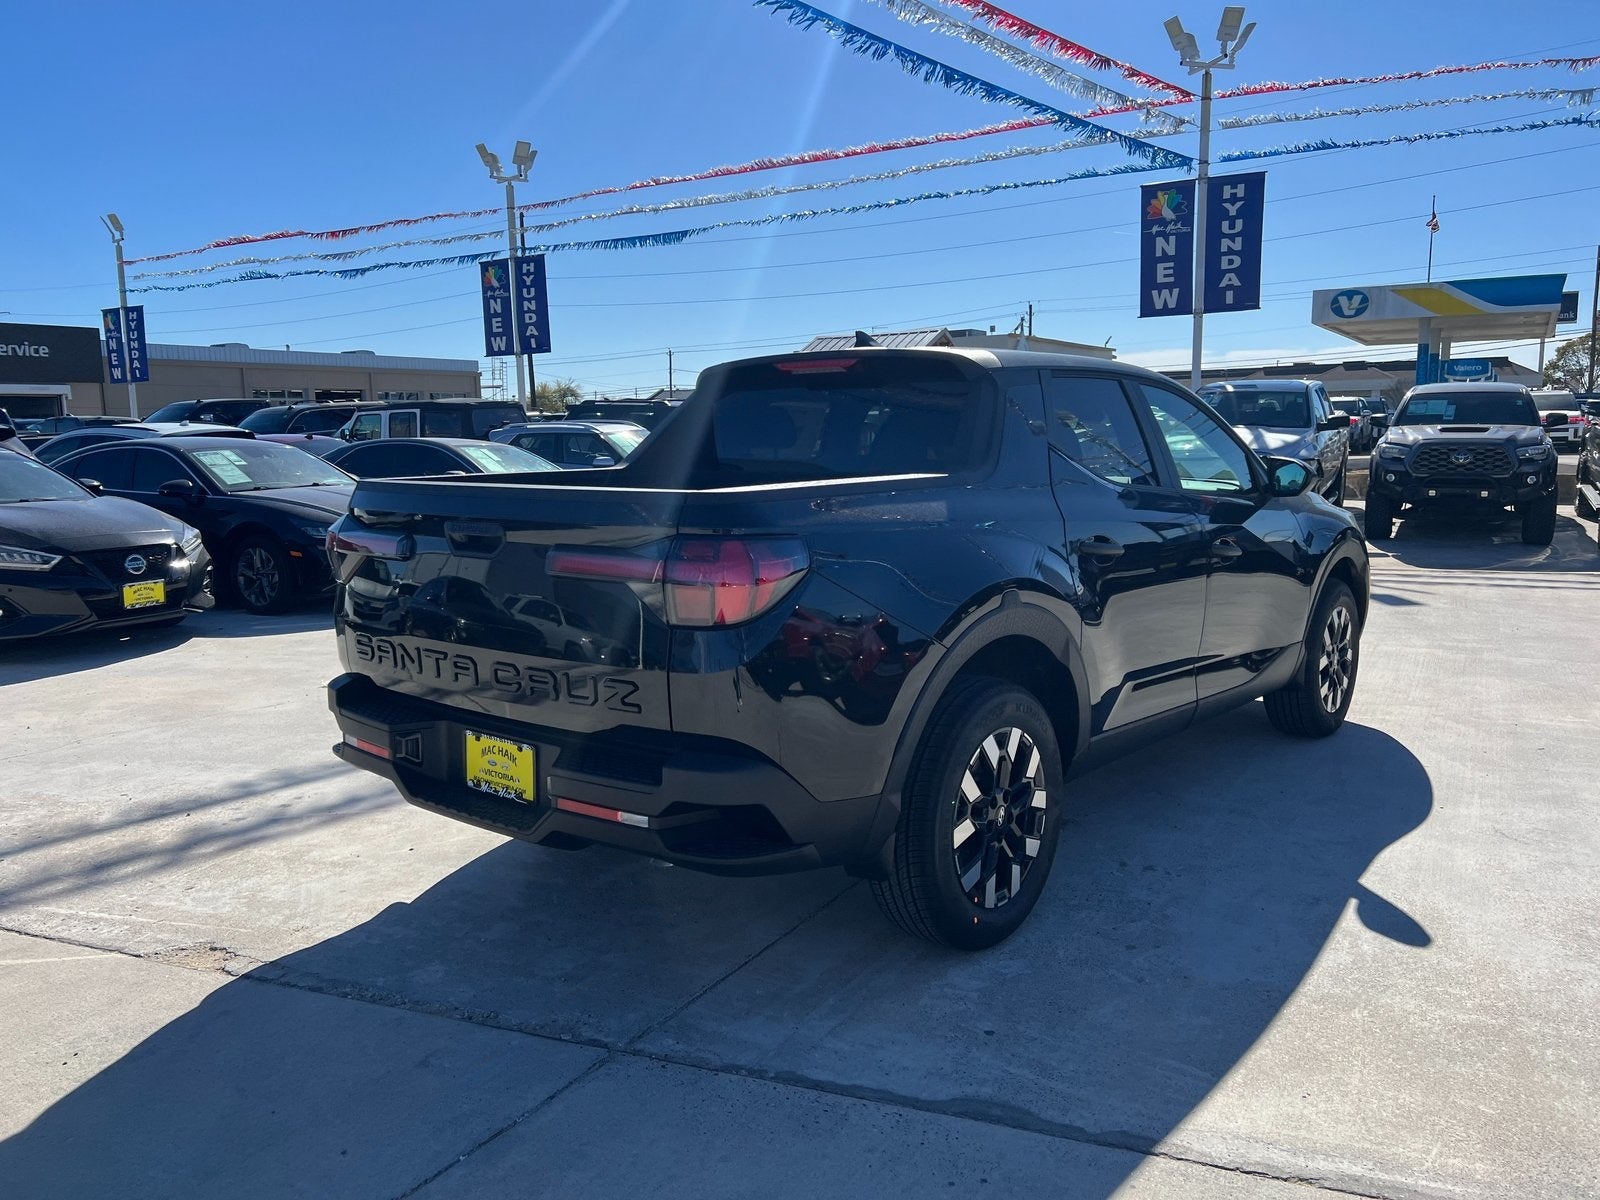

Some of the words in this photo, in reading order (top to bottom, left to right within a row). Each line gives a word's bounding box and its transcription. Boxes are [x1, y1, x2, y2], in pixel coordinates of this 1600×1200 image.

[1218, 183, 1246, 305] HYUNDAI
[1151, 235, 1180, 310] NEW
[489, 298, 507, 352] NEW
[522, 262, 539, 349] HYUNDAI
[1558, 311, 1575, 319] ank
[0, 341, 49, 357] ervice
[108, 338, 122, 380] NEW
[128, 311, 141, 378] HYUNDAI
[1453, 364, 1482, 373] Valero
[354, 632, 480, 687] SANTA
[491, 660, 643, 714] CRUZ
[481, 745, 497, 758] MAC
[498, 746, 517, 767] HAIK
[484, 768, 515, 782] VICTORIA
[480, 781, 498, 795] Mac
